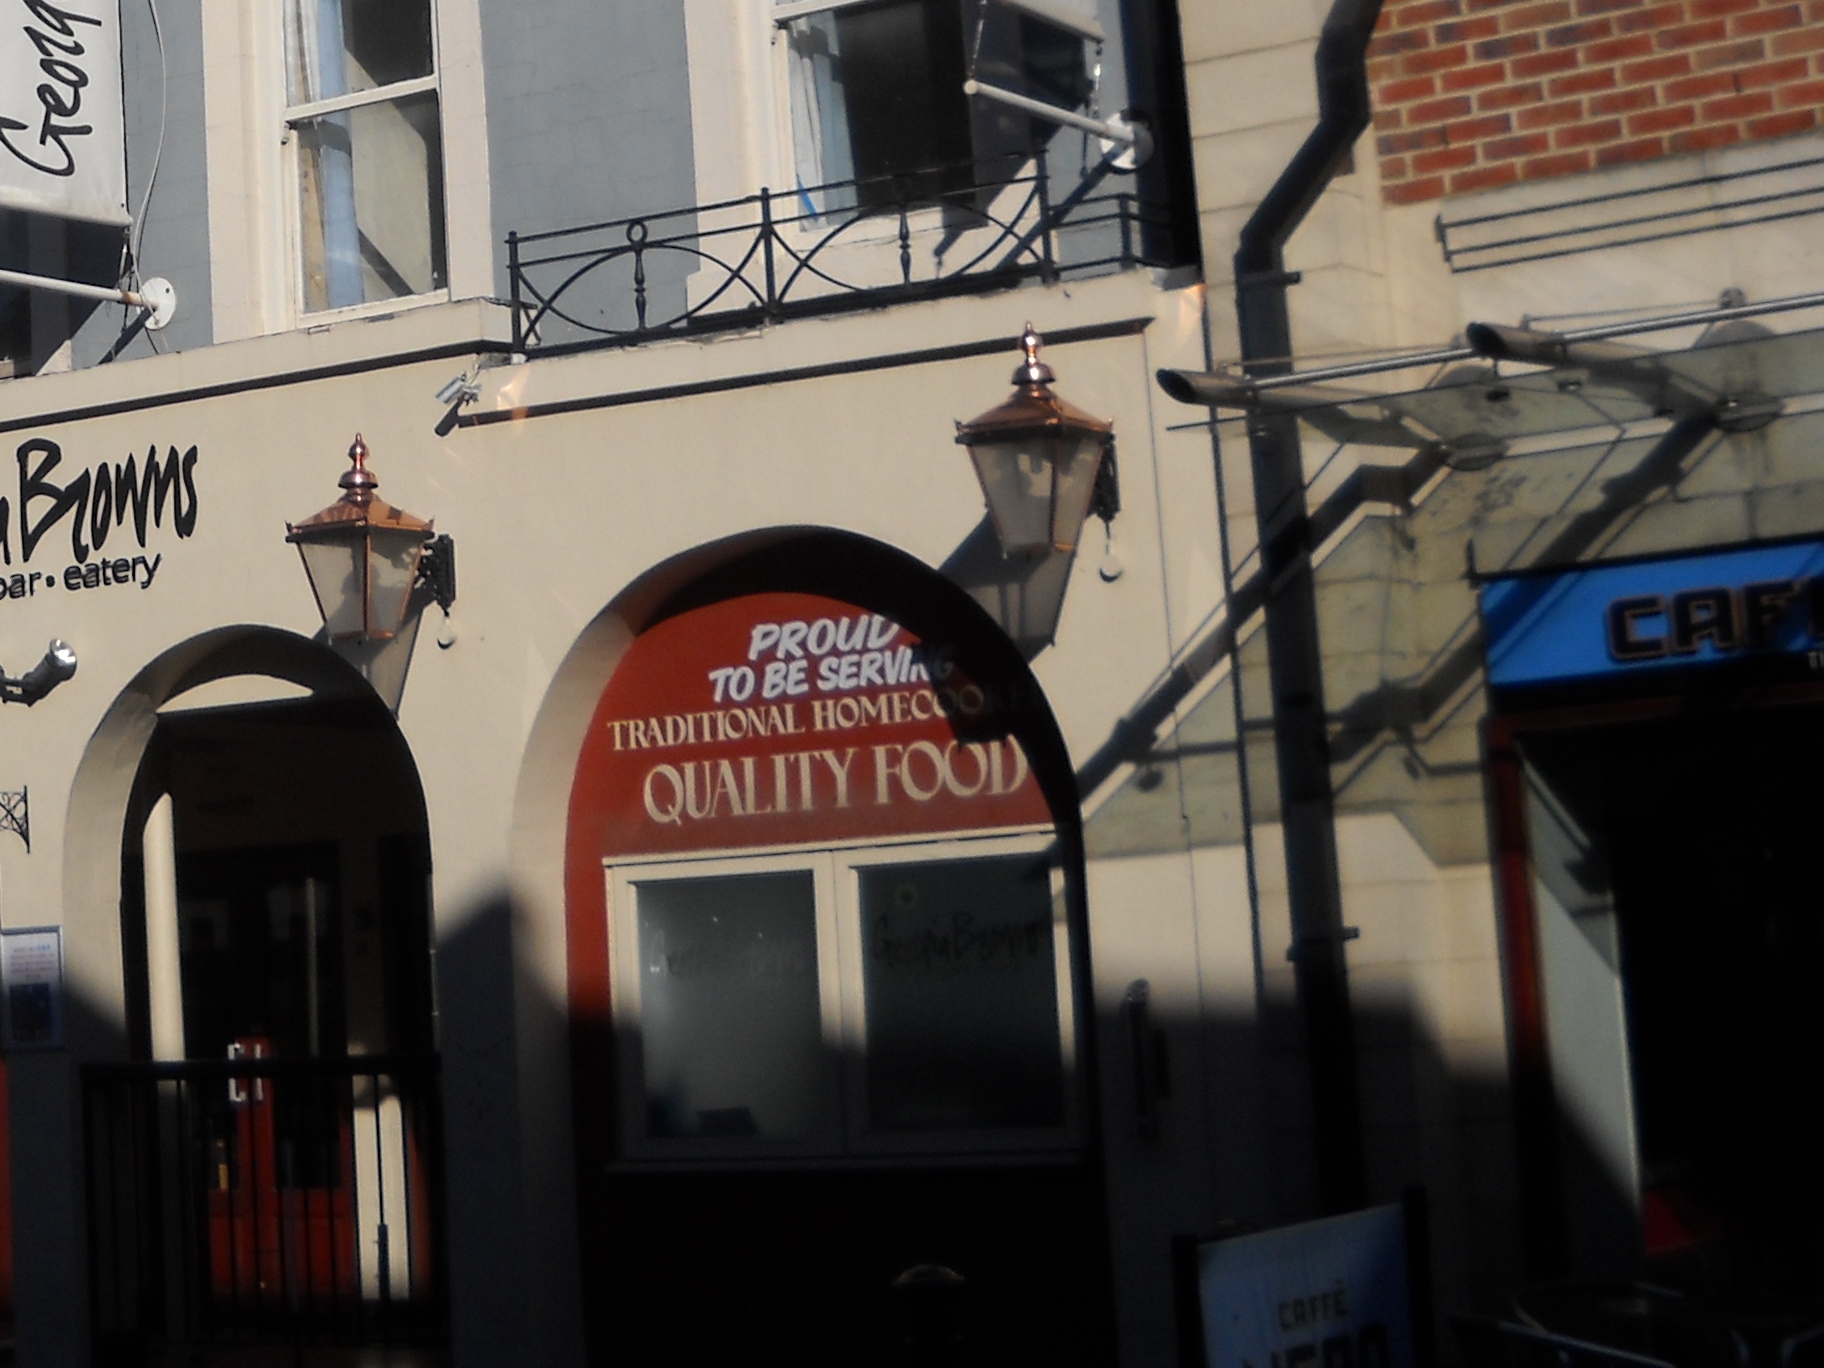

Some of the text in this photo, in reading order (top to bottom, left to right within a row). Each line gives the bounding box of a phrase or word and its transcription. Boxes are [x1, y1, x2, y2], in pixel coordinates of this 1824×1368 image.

[16, 437, 198, 564] Browns
[63, 552, 164, 591] eatery
[747, 613, 902, 663] PROUD
[1608, 577, 1824, 661] CAF
[708, 665, 755, 704] TO
[762, 659, 808, 700] BE
[607, 704, 806, 753] TRADITIONAL
[642, 735, 1029, 827] QUALITY FOOD
